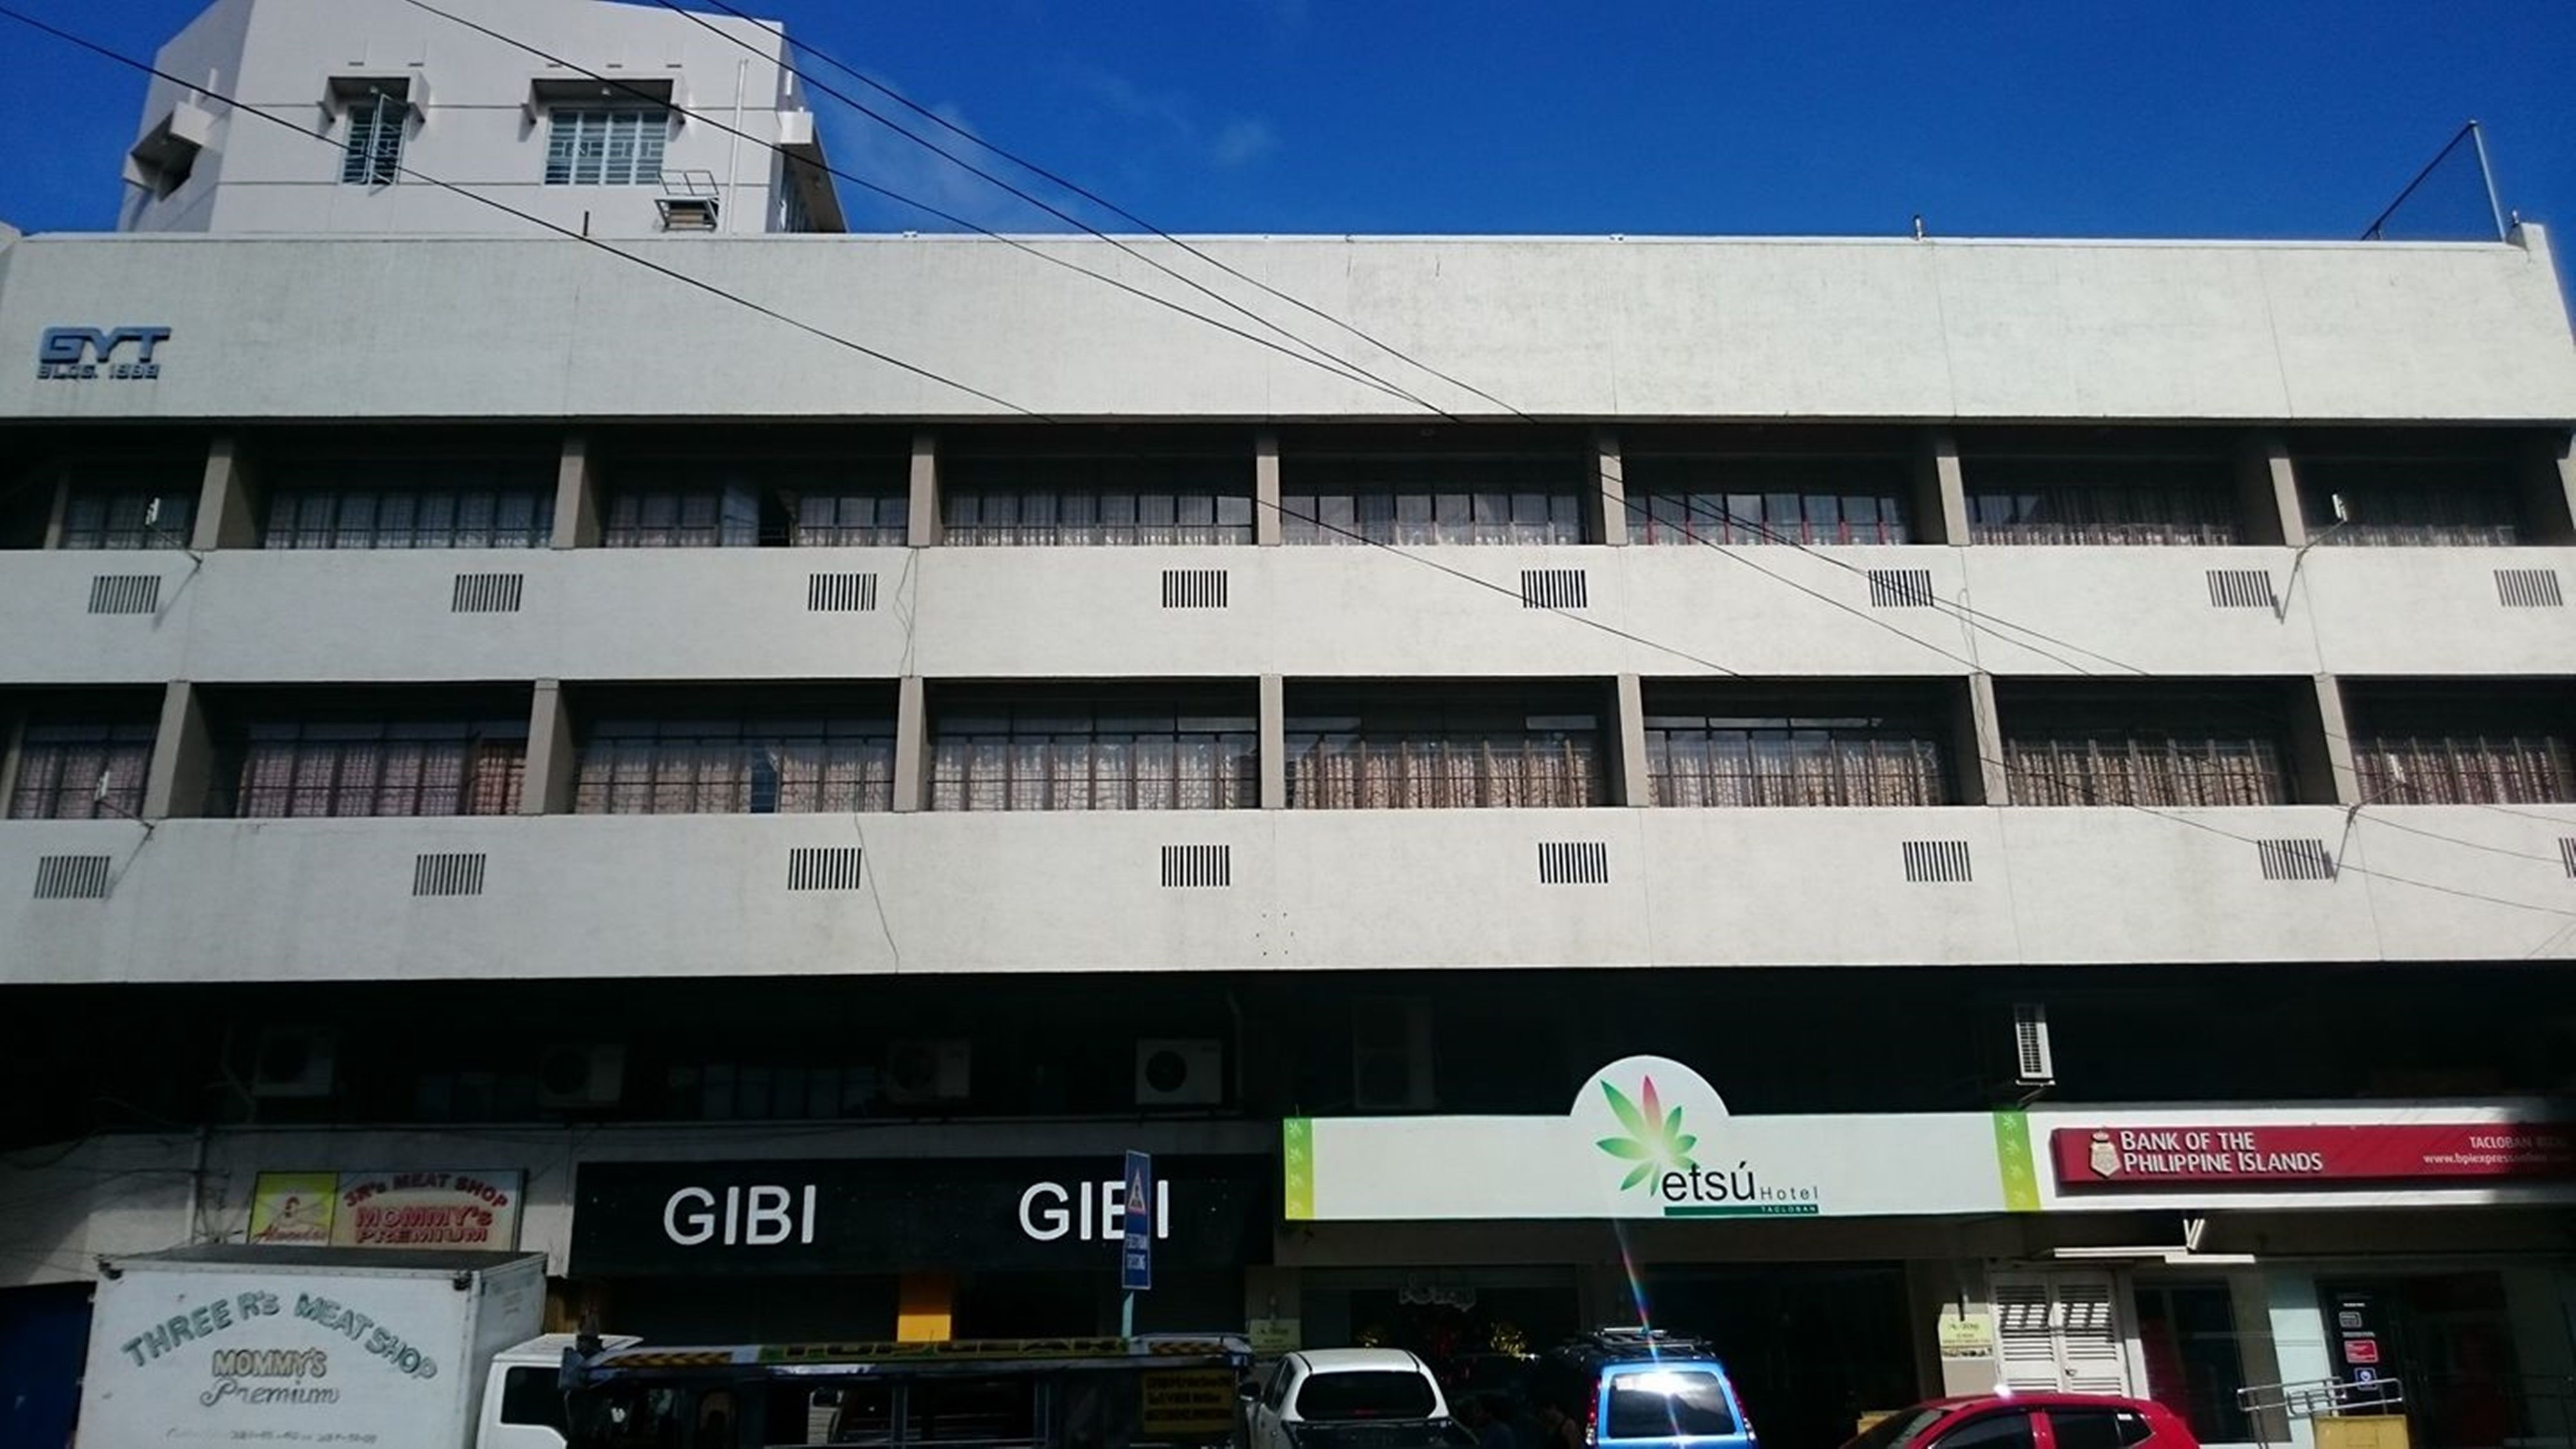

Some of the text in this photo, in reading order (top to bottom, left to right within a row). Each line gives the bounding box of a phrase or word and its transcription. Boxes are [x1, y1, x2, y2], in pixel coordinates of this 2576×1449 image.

[39, 327, 171, 363] GYT
[2121, 1131, 2255, 1151] BANK OF THE
[2468, 1135, 2533, 1149] TACLOBAN
[2124, 1151, 2324, 1173] PHILIPPINE ISLANDS
[393, 1172, 451, 1189] MEAT
[455, 1176, 508, 1207] SHOP
[1760, 1186, 1818, 1200] Hotel
[664, 1185, 817, 1245] GIBI
[356, 1227, 488, 1244] PREMIUM
[121, 1299, 233, 1367] THREE
[295, 1293, 374, 1341] MEAT
[365, 1327, 437, 1379] SHOP
[200, 1377, 339, 1407] Premium
